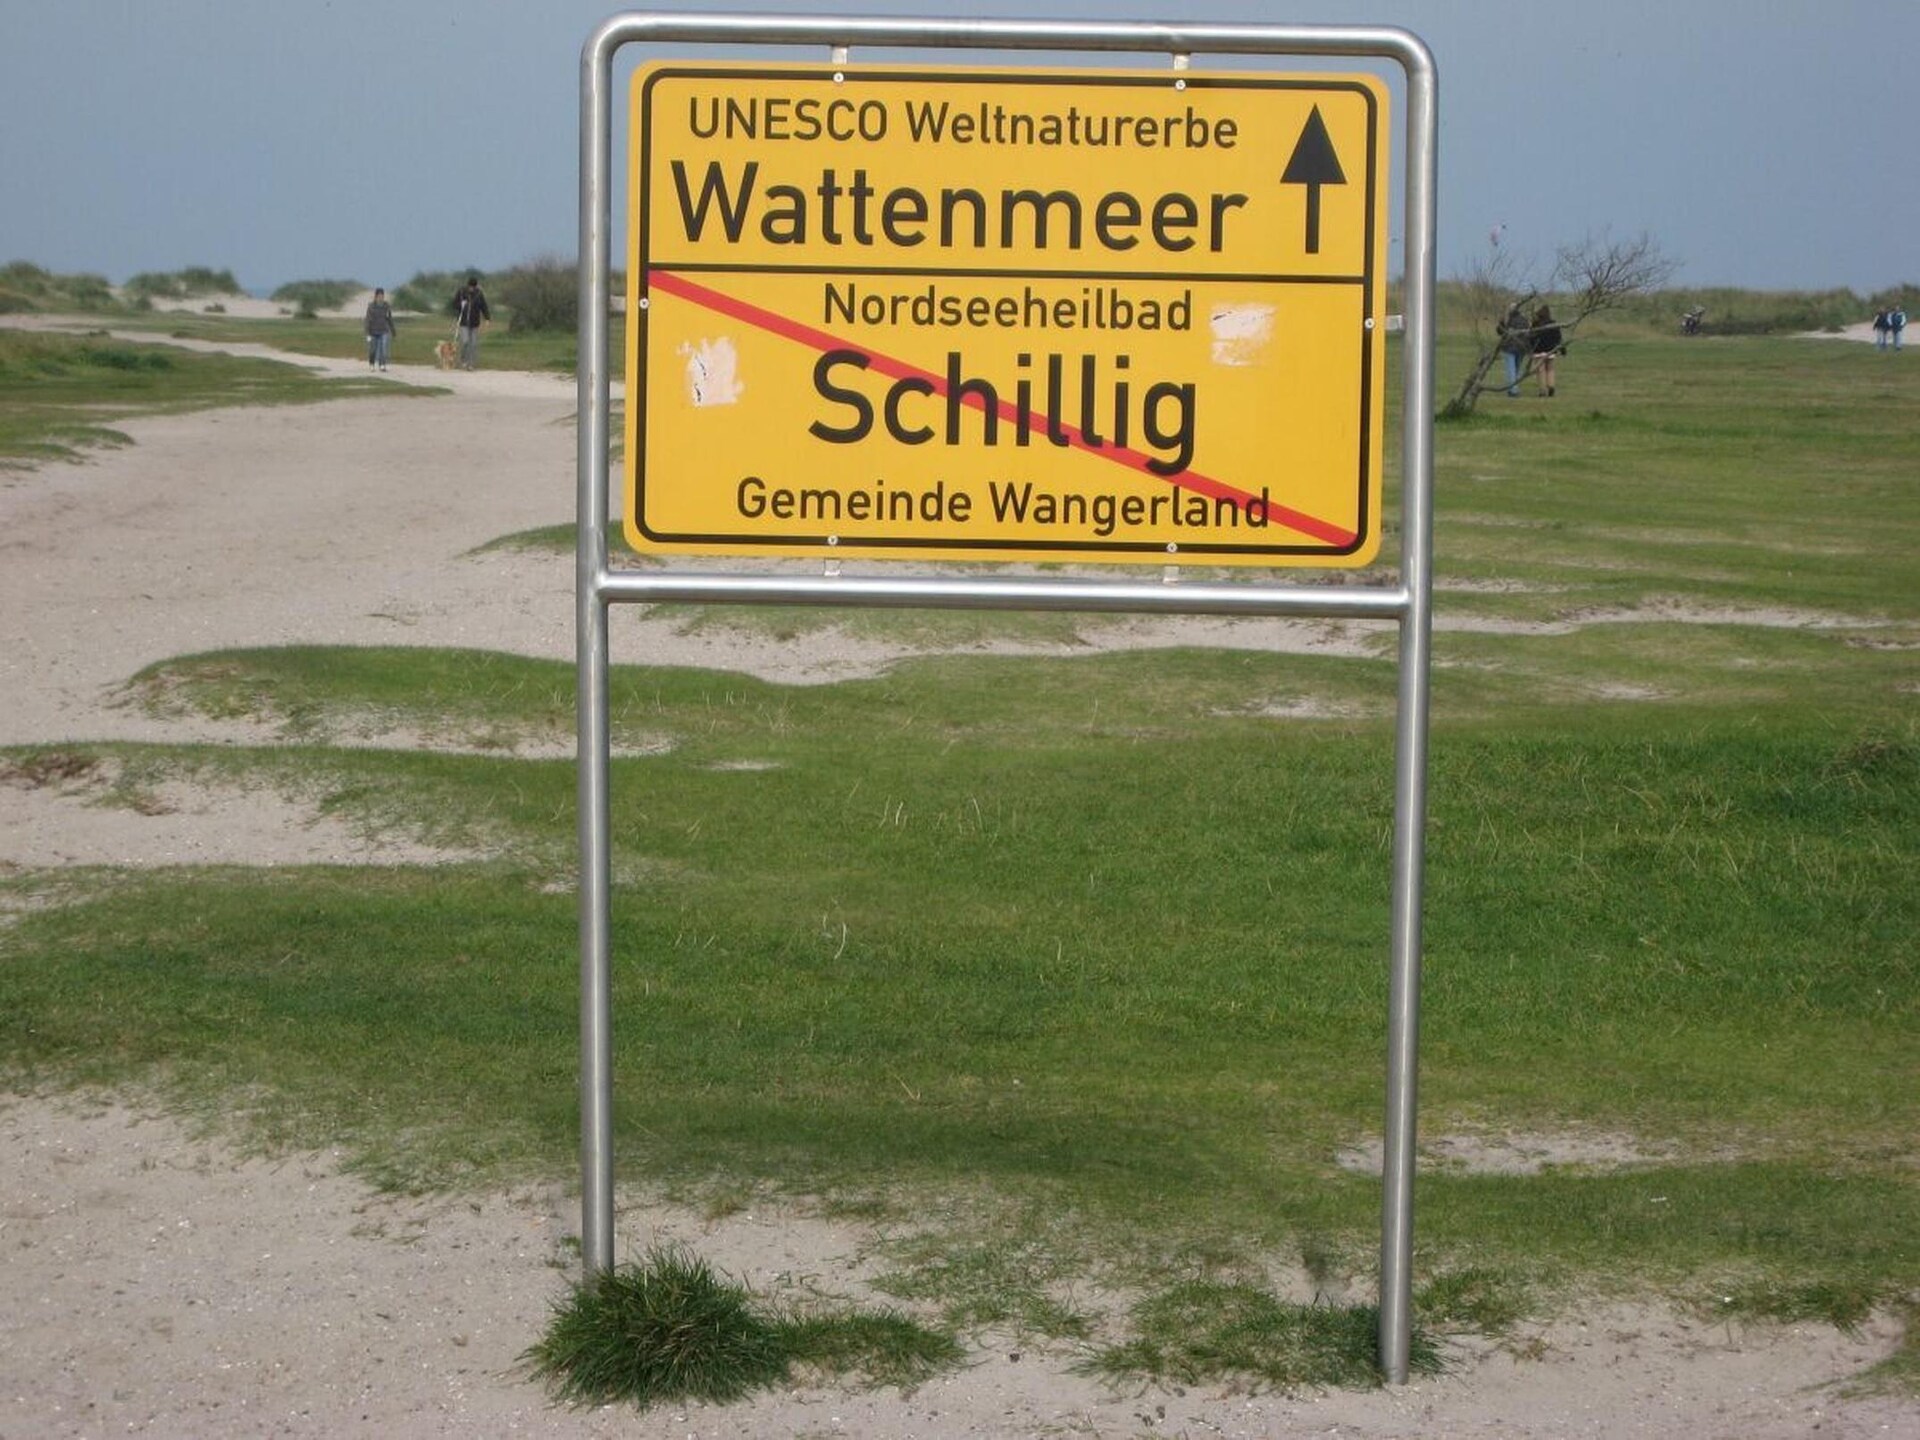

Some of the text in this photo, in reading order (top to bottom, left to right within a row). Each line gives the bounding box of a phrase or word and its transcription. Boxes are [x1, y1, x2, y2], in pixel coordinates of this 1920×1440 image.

[690, 97, 1238, 148] UNESCO Weltnaturerbe
[670, 160, 1249, 252] Wattenmeer
[824, 283, 1192, 330] Nordseeheilbad
[808, 349, 1197, 477] Schillig
[737, 477, 1270, 536] Gemeinde Wangerland
